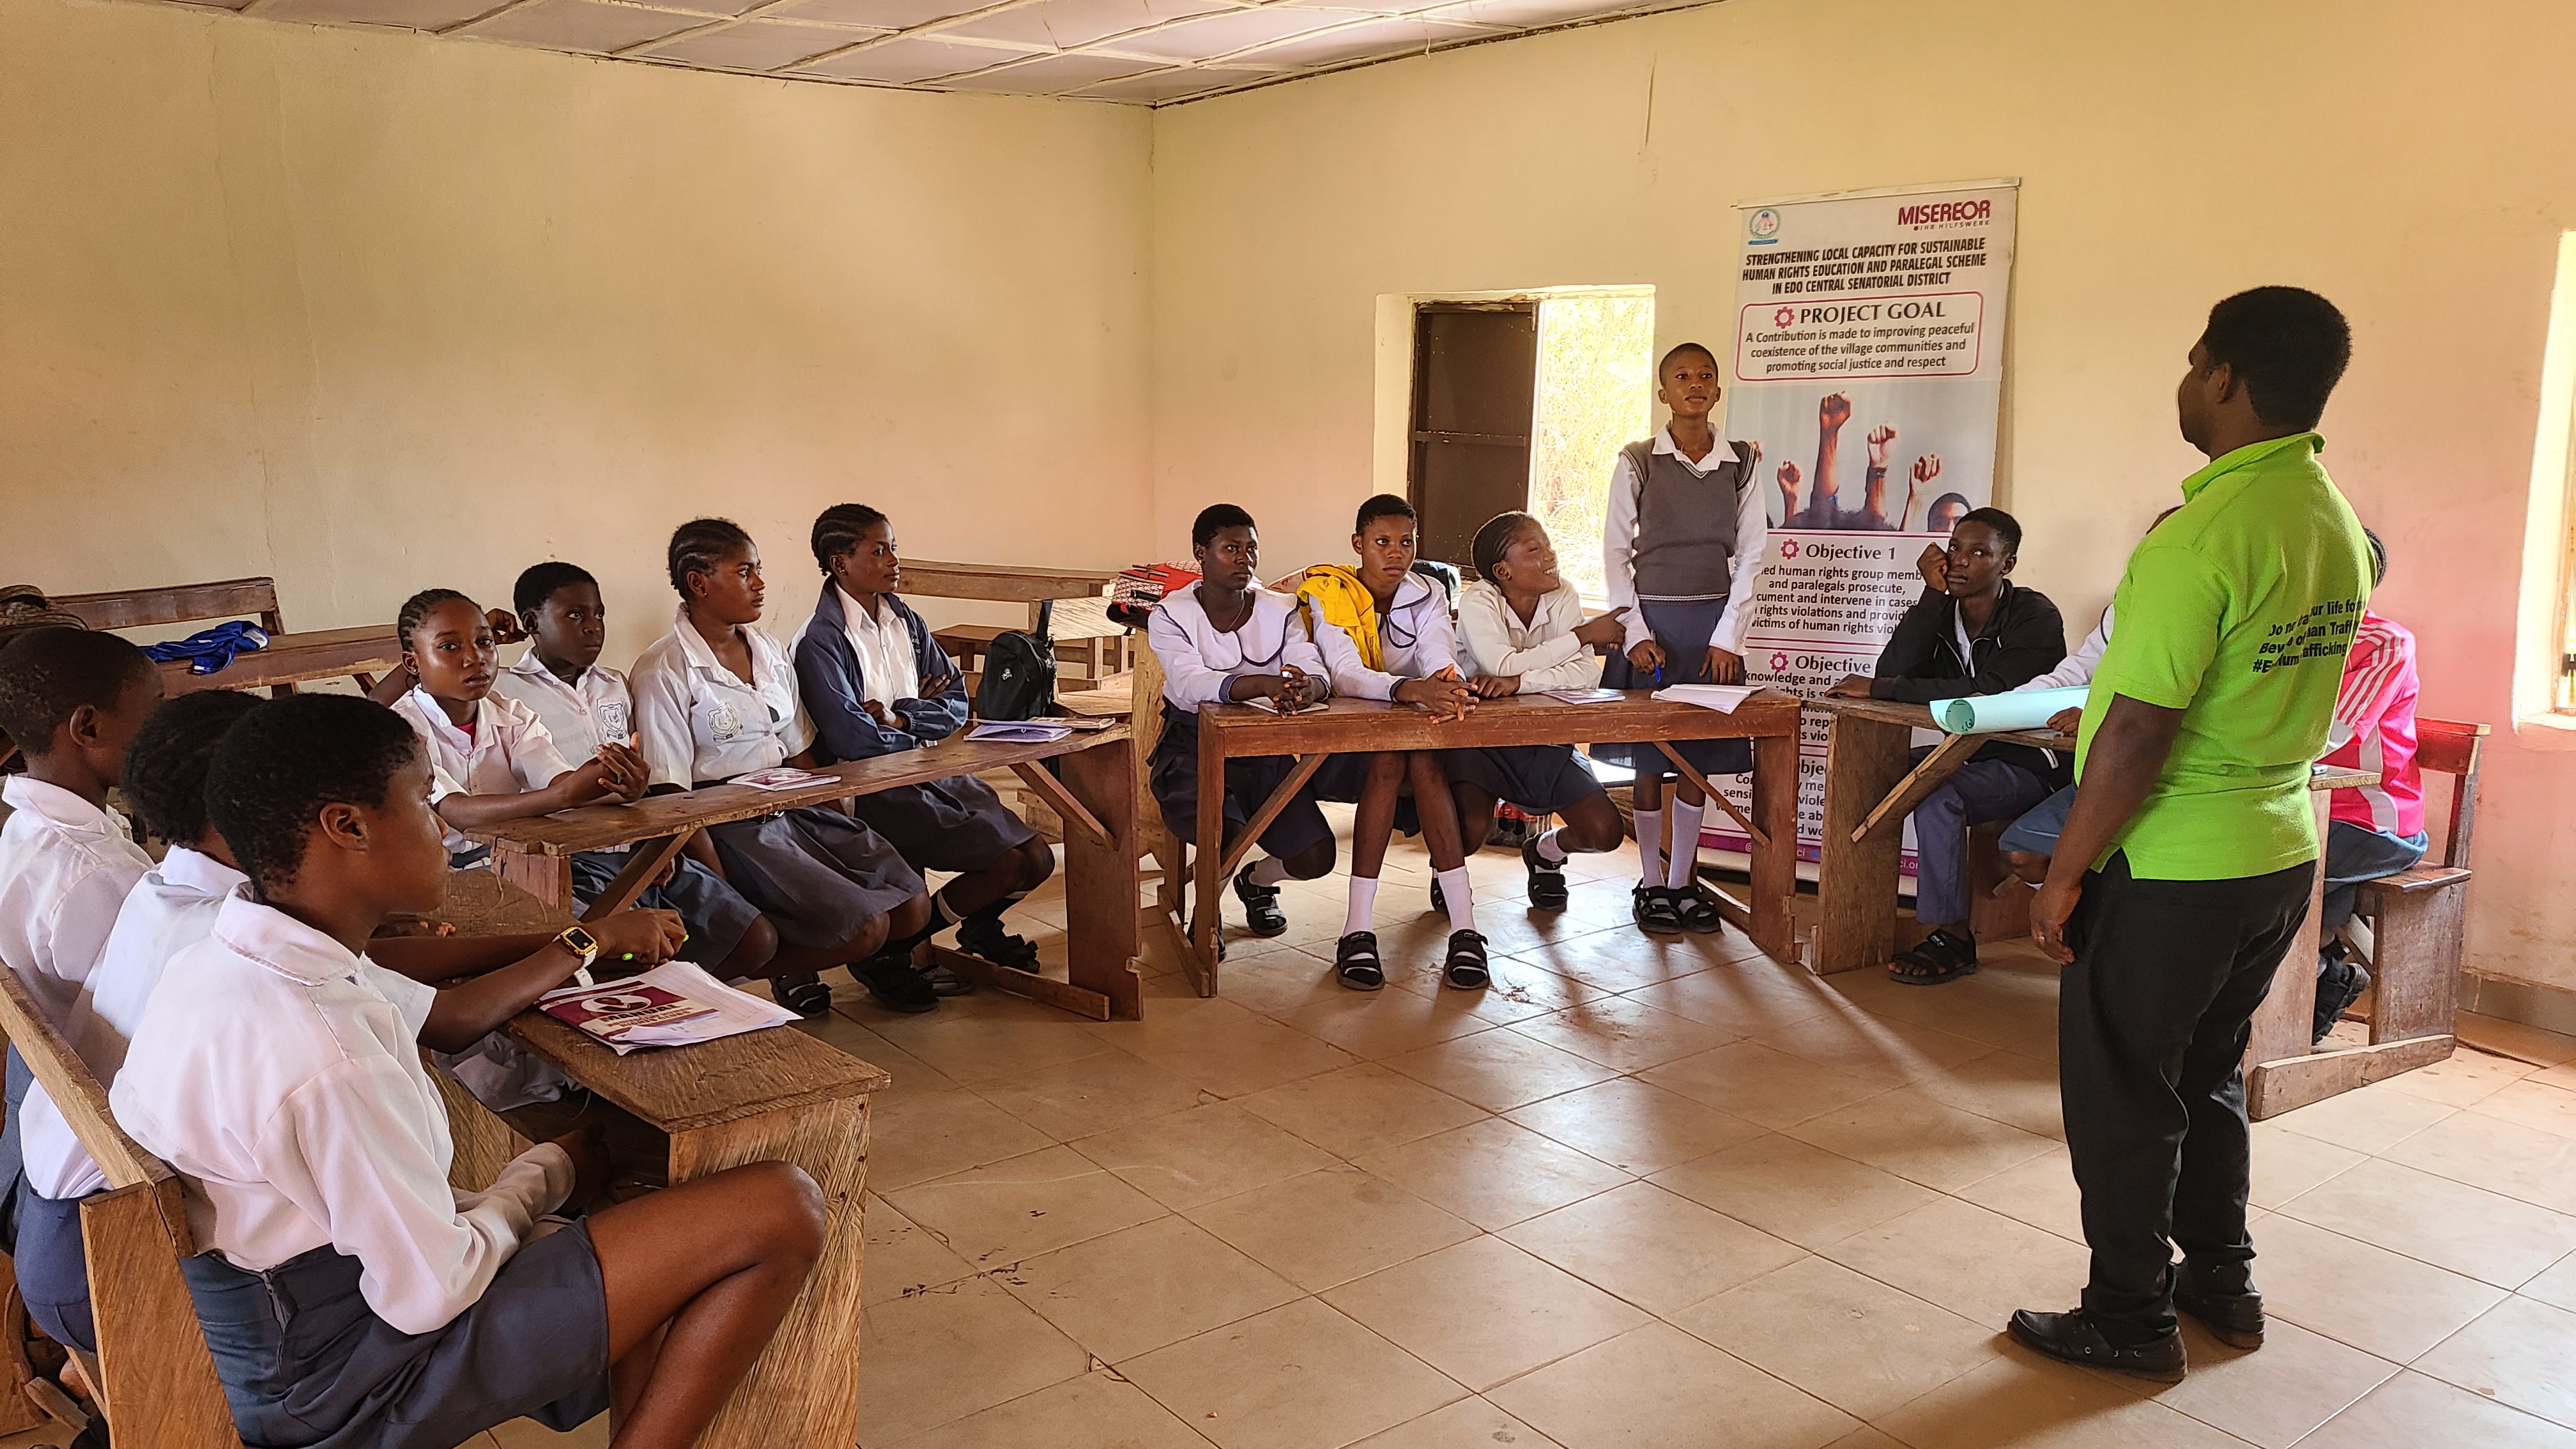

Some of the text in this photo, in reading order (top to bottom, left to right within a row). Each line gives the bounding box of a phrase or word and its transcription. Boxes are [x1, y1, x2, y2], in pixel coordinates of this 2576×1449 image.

[1897, 199, 1991, 225] MISEREOR
[1938, 220, 1990, 229] HILFSWERK
[1745, 237, 1986, 266] STRENGTHENING LOCAL CAPACITY FOR SUSTAINABLE
[1742, 253, 1986, 280] HUMAN RIGHTS EDUCATION AND PARALEGAL SCHEME
[1772, 272, 1951, 295] IN EDO CENTRAL SENATORIAL DISTRICT
[1800, 302, 1946, 325] PROJECT GOAL
[1745, 321, 1975, 343] A Contribution is made to improving peaceful
[1751, 338, 1966, 358] coexistence of the village communities and
[1766, 356, 1946, 374] promoting social justice and respect
[1805, 543, 1896, 562] Objective 1
[1761, 565, 1775, 575] ed
[1779, 565, 1815, 576] human
[1818, 566, 1849, 579] rights
[1851, 569, 1884, 581] group
[1768, 578, 1906, 595] and paralegals prosecute,
[1797, 593, 1818, 604] and
[1820, 593, 1872, 606] intervene
[1875, 595, 1885, 606] in
[2327, 601, 2343, 615] life
[1759, 604, 1788, 617] rights
[1791, 606, 1843, 618] violations
[1846, 609, 1867, 619] and
[1752, 617, 1786, 629] victims
[1788, 619, 1800, 629] of
[1802, 619, 1840, 631] human
[1843, 622, 1874, 634] rights
[1795, 655, 1871, 673] Objective
[1745, 671, 1805, 686] knowledge
[1809, 675, 1831, 686] and
[1807, 688, 1816, 698] is
[1800, 759, 1825, 778] bje
[599, 1004, 682, 1022] MANUAL
